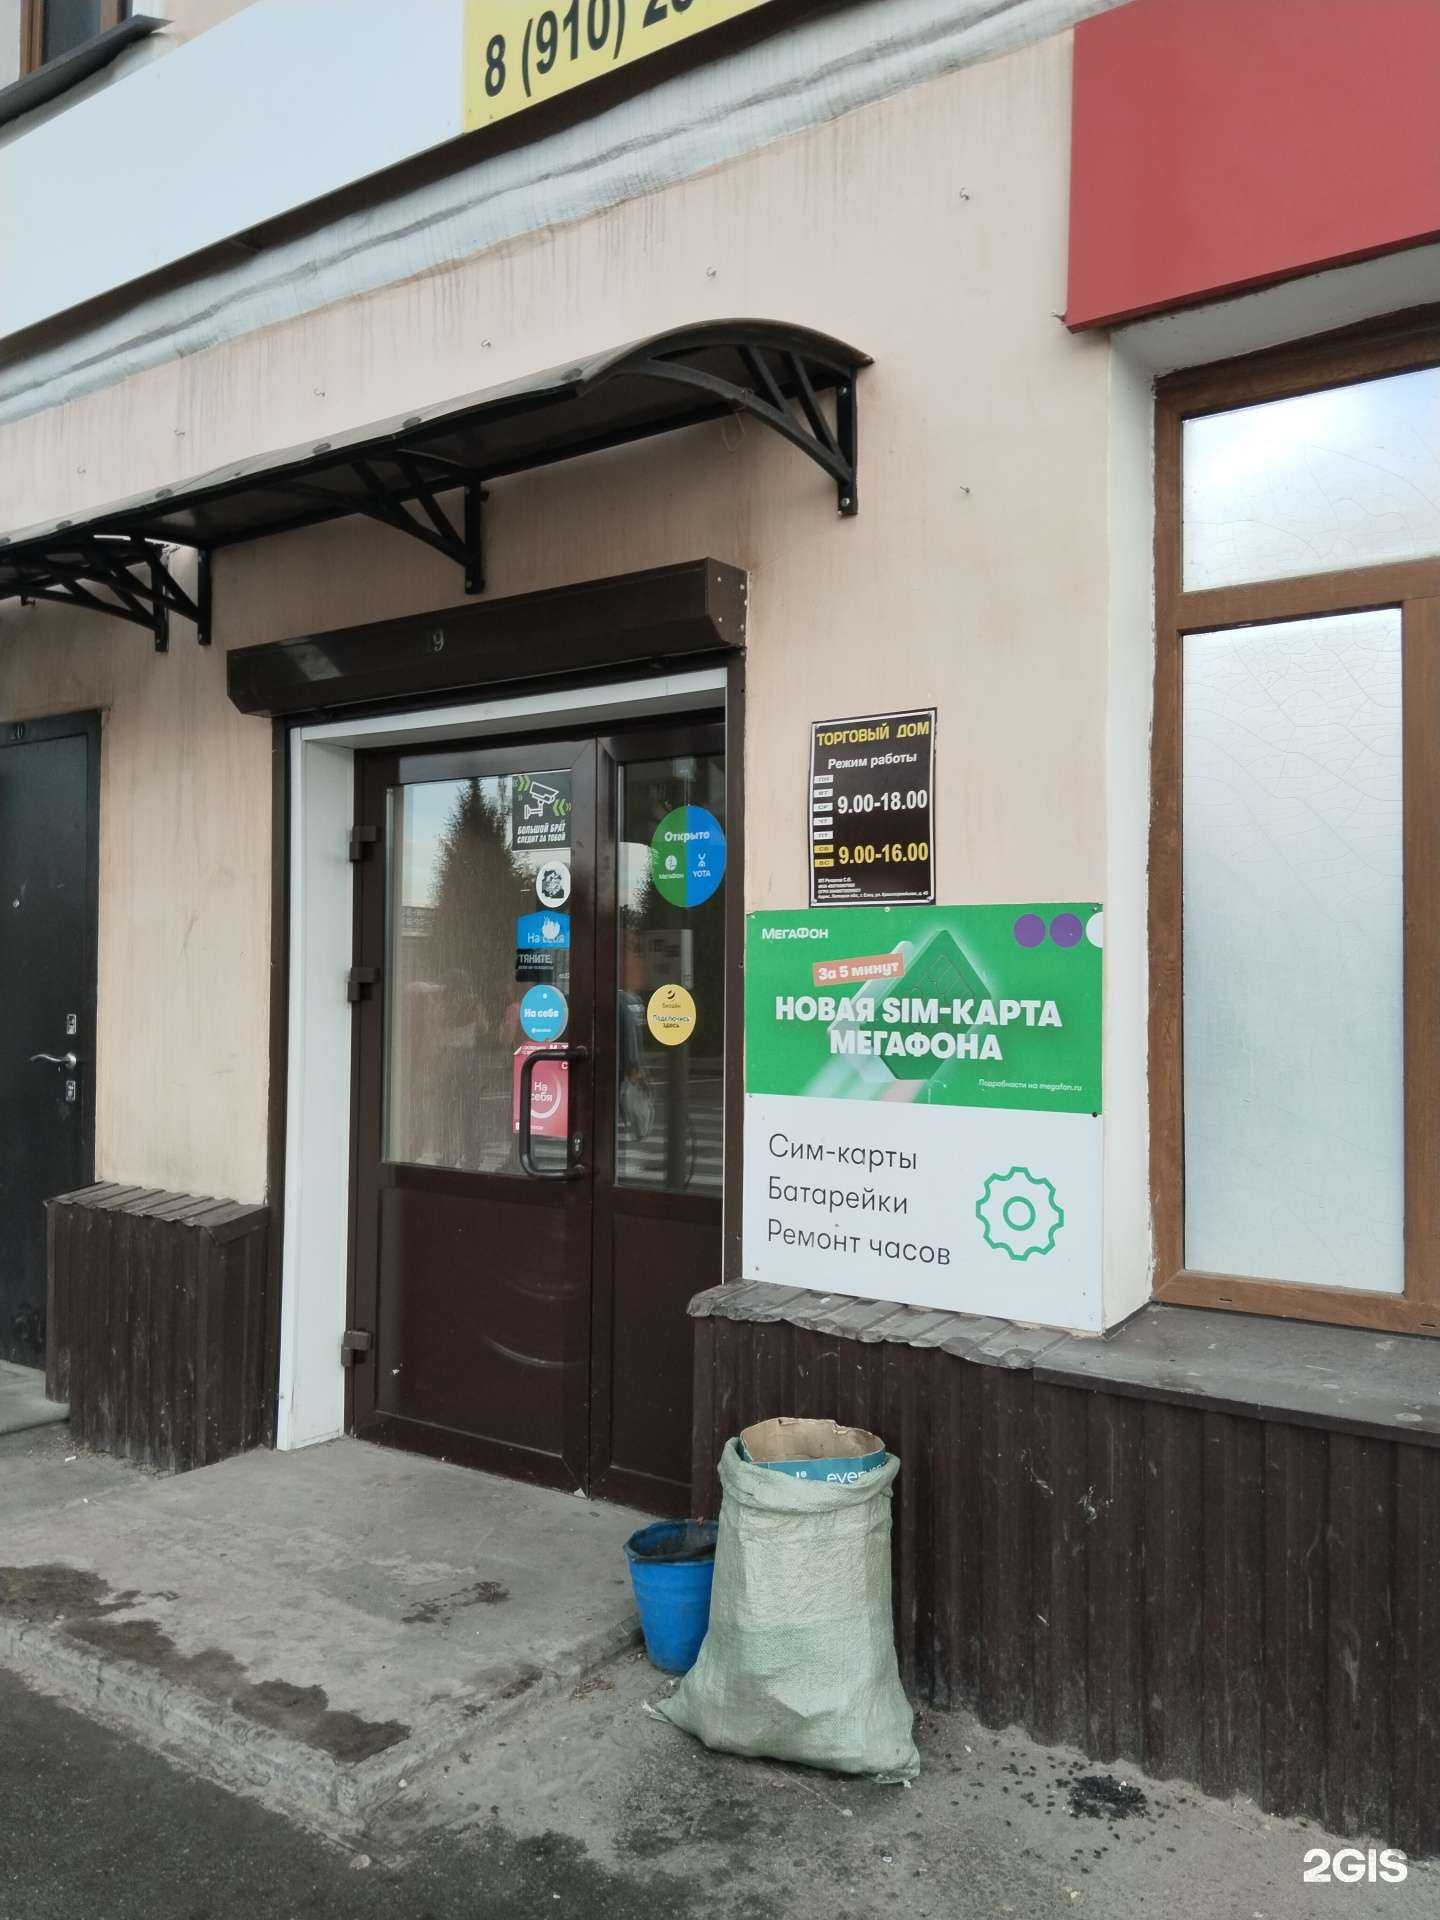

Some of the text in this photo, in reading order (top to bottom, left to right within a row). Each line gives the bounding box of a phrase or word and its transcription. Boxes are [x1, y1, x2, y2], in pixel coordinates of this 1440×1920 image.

[485, 0, 627, 98] 8 (910)
[816, 720, 930, 747] ТОРГОВЫЙ ДОМ
[828, 752, 918, 770] Режим работы
[837, 789, 928, 815] 9.00-18.00
[664, 831, 710, 843] Открыто
[838, 842, 929, 865] 9.00-16.00
[692, 870, 711, 878] YOTA
[519, 953, 553, 964] ТЯНИТЕ
[818, 961, 900, 981] За 5 минут
[775, 996, 1063, 1028] НОВАЯ SIM-КАРТА
[830, 1029, 1004, 1060] МЕГАФОНА
[534, 1081, 548, 1092] На
[768, 1133, 917, 1173] Сим-карты
[768, 1176, 908, 1214] Батарейки
[768, 1218, 951, 1266] Ремонт часов
